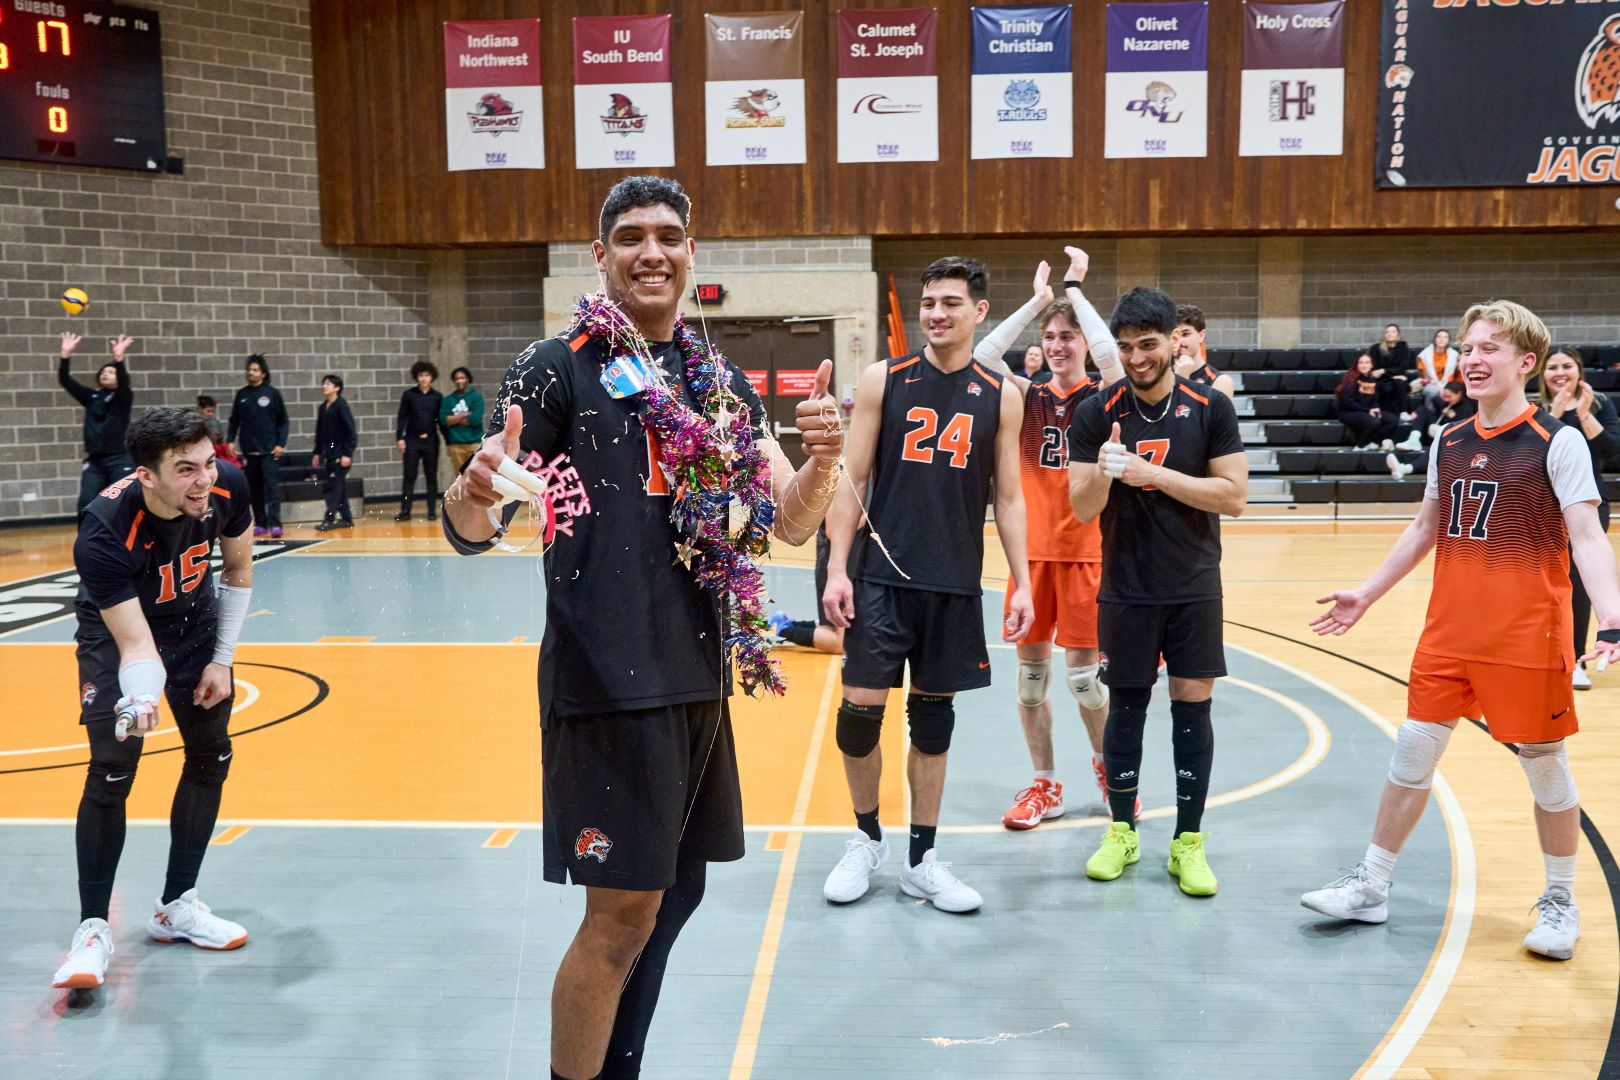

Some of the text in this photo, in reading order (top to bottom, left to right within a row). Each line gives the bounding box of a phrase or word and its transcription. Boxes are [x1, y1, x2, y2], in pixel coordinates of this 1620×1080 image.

[14, 0, 66, 18] Guests
[858, 23, 917, 38] Calumet
[1001, 19, 1044, 35] Trinity
[1136, 16, 1178, 31] Olivet
[1256, 15, 1331, 30] Holy Cross
[37, 20, 71, 56] 17
[614, 30, 631, 44] IU
[716, 25, 793, 41] St. Francis
[467, 34, 519, 49] Indiana
[989, 38, 1054, 54] Christian
[1123, 37, 1190, 52] Nazarene
[582, 48, 664, 64] South Bend
[850, 41, 924, 59] St. Joseph
[459, 53, 529, 68] Northwest
[35, 81, 70, 99] fouls
[48, 106, 68, 133] 0
[699, 285, 719, 300] EXIT
[902, 406, 974, 469] 24
[1136, 438, 1170, 491] 7
[522, 450, 574, 537] PARTY
[1447, 479, 1498, 540] 17
[156, 540, 210, 604] 15
